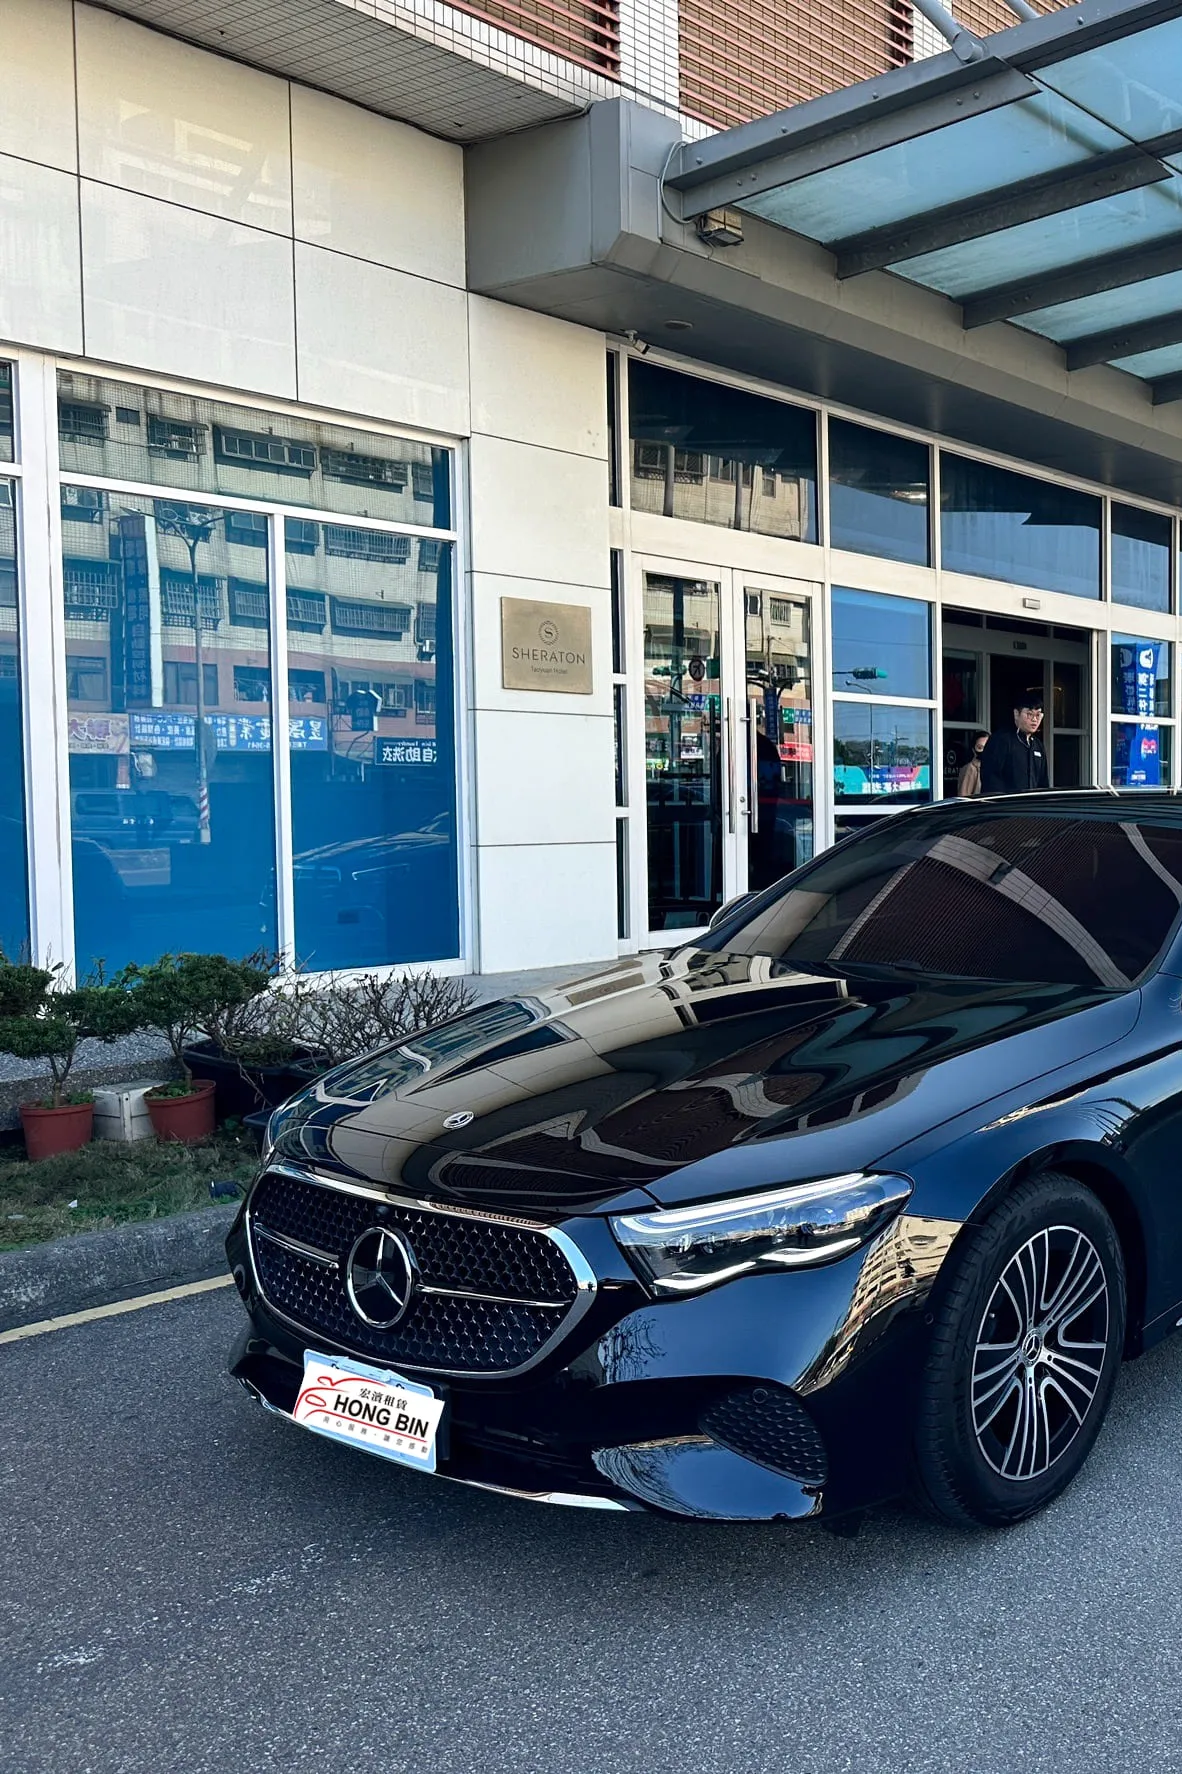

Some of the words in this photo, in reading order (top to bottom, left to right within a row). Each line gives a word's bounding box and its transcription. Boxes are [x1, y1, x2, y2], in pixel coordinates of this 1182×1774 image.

[511, 646, 586, 665] SHERATON
[359, 1387, 409, 1412] 宏濱租賃
[333, 1394, 392, 1427] HONG
[394, 1413, 430, 1439] BIN
